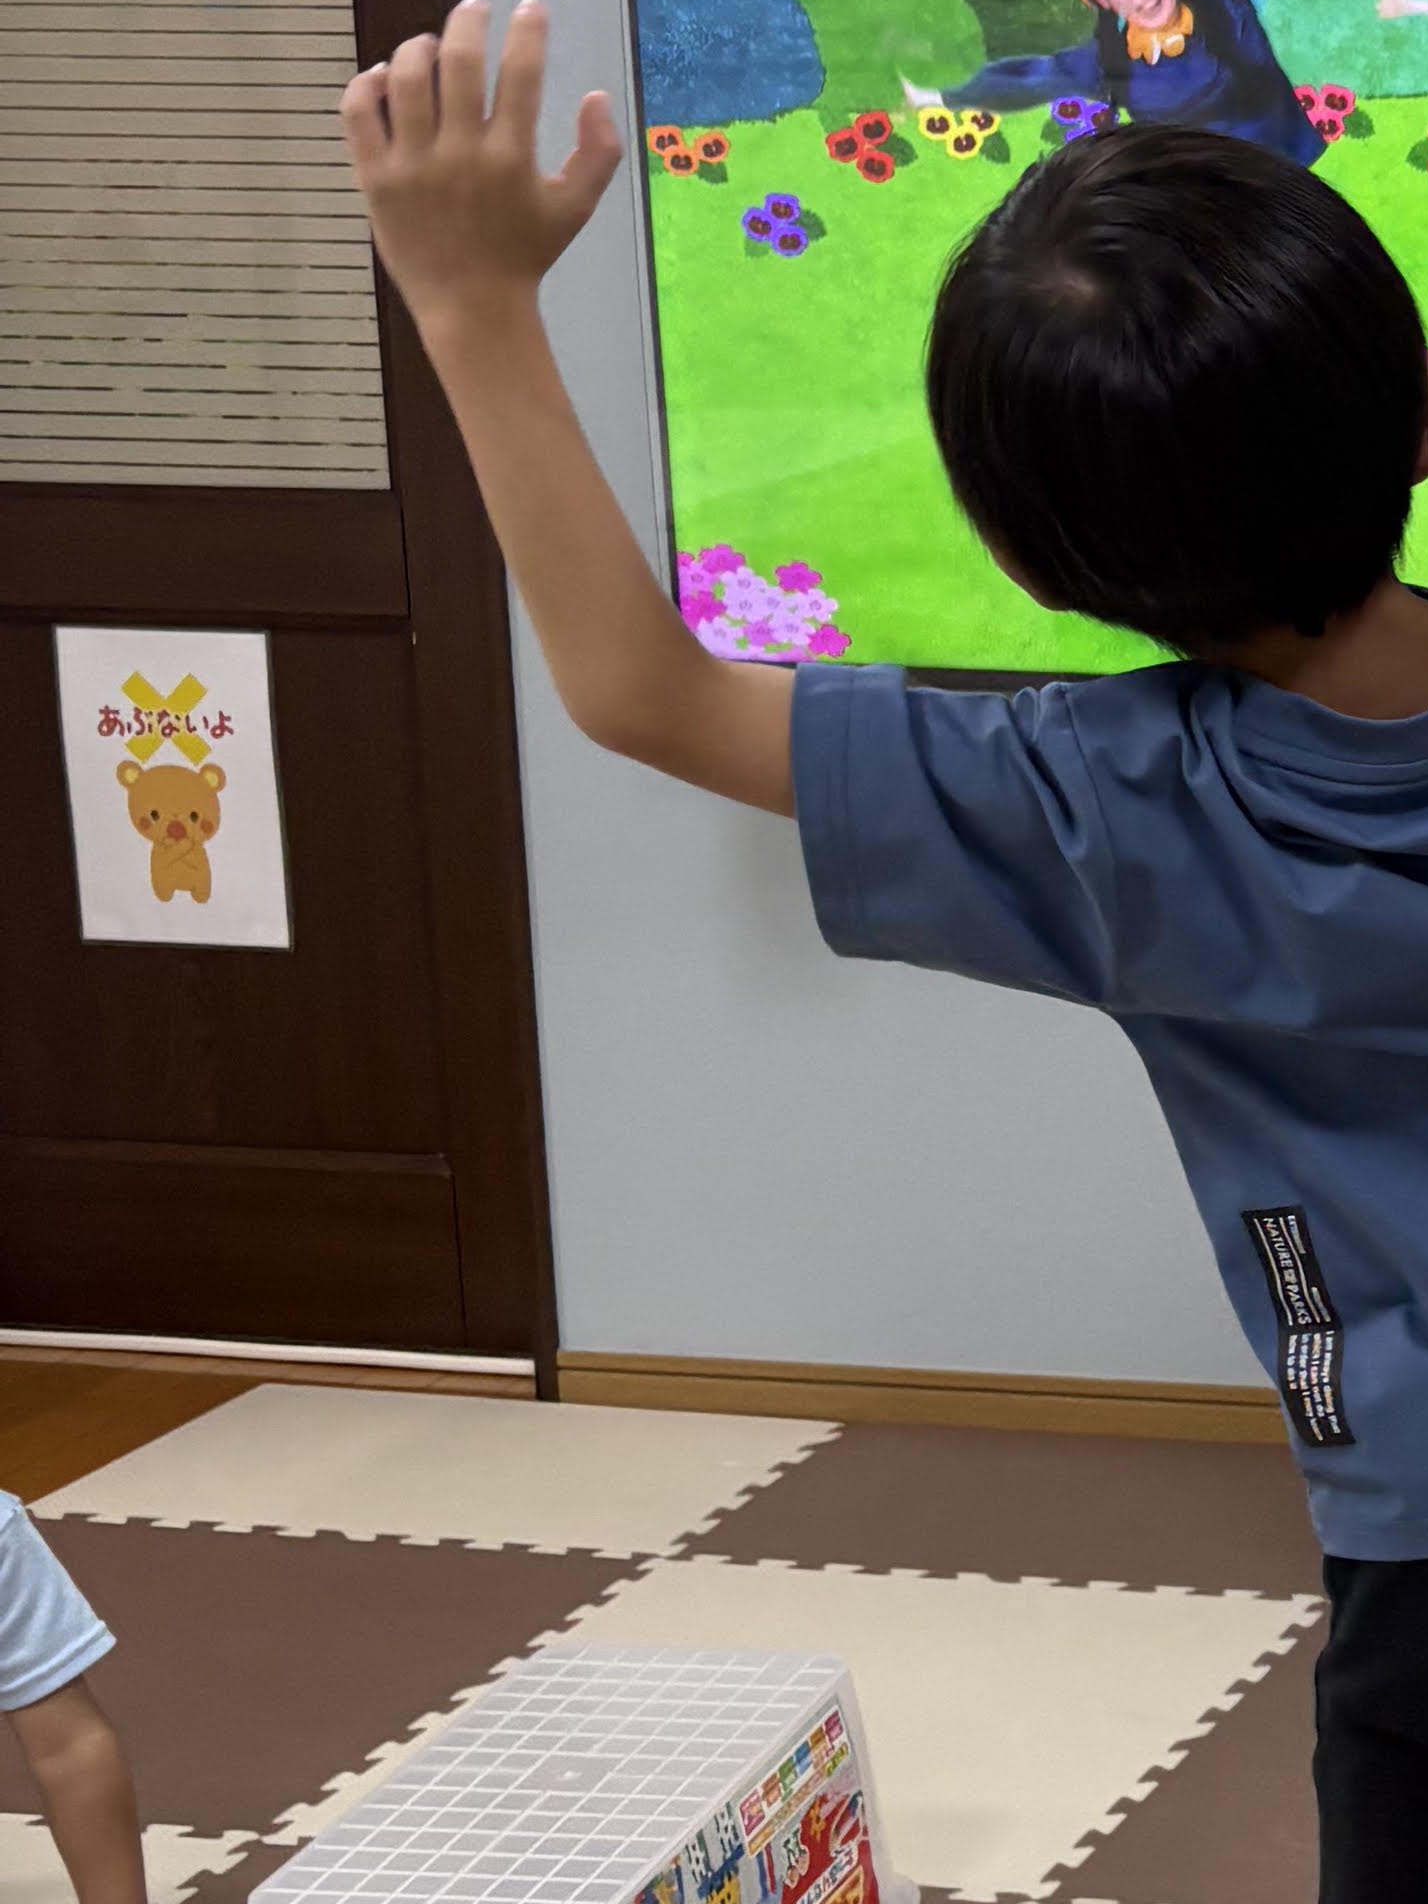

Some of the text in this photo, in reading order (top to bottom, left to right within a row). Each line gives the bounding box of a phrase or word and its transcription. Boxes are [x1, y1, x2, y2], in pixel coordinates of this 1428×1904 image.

[97, 704, 235, 740] あぶないよ
[1263, 1217, 1293, 1268] NATURE
[1286, 1283, 1312, 1325] PARKS
